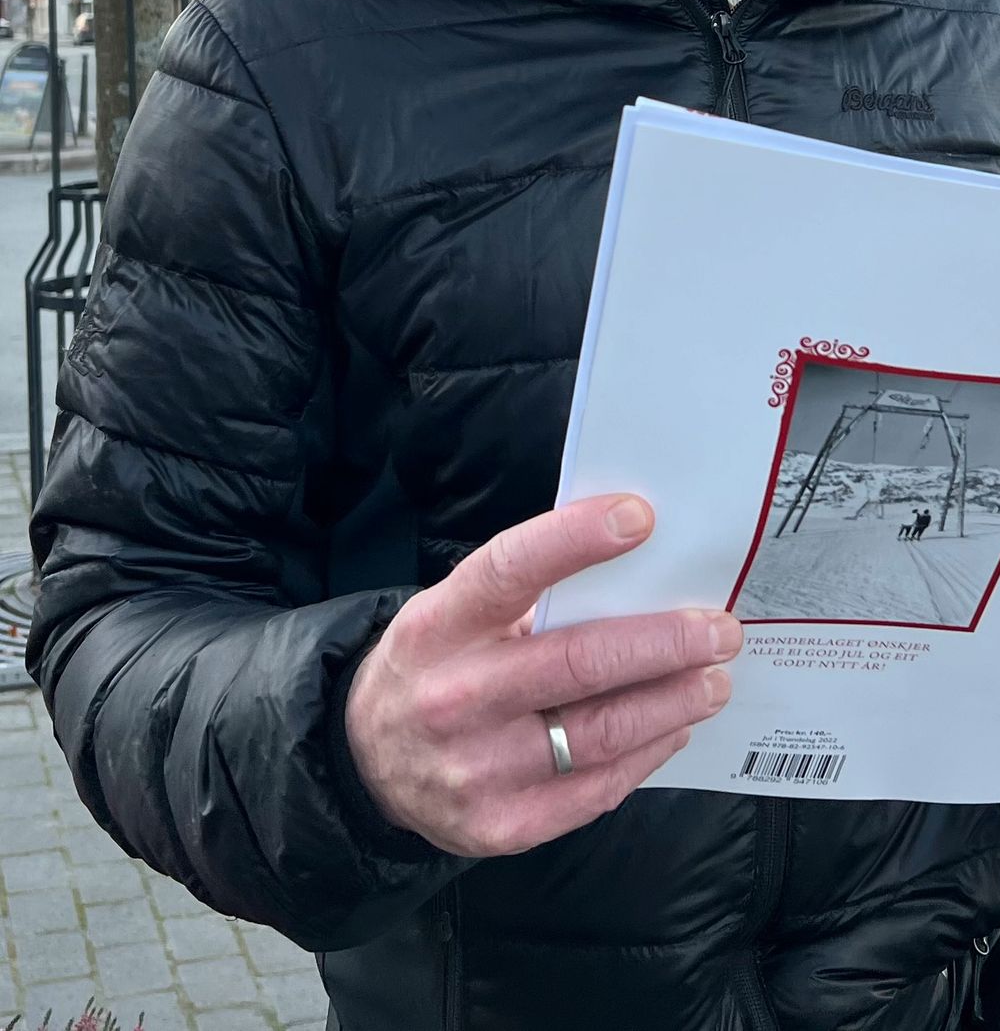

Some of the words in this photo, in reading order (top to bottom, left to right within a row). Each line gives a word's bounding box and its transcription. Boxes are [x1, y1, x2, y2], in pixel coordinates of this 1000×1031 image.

[745, 637, 864, 648] TRØNDERLAGET
[867, 640, 931, 652] ØNSKJER
[748, 648, 785, 656] ALLE
[788, 649, 802, 657] EI
[805, 649, 838, 658] GOD
[840, 650, 865, 659] JUL
[869, 651, 892, 661] OG
[894, 652, 919, 662] EIT
[773, 659, 817, 668] GODT
[818, 660, 859, 669] NYTT
